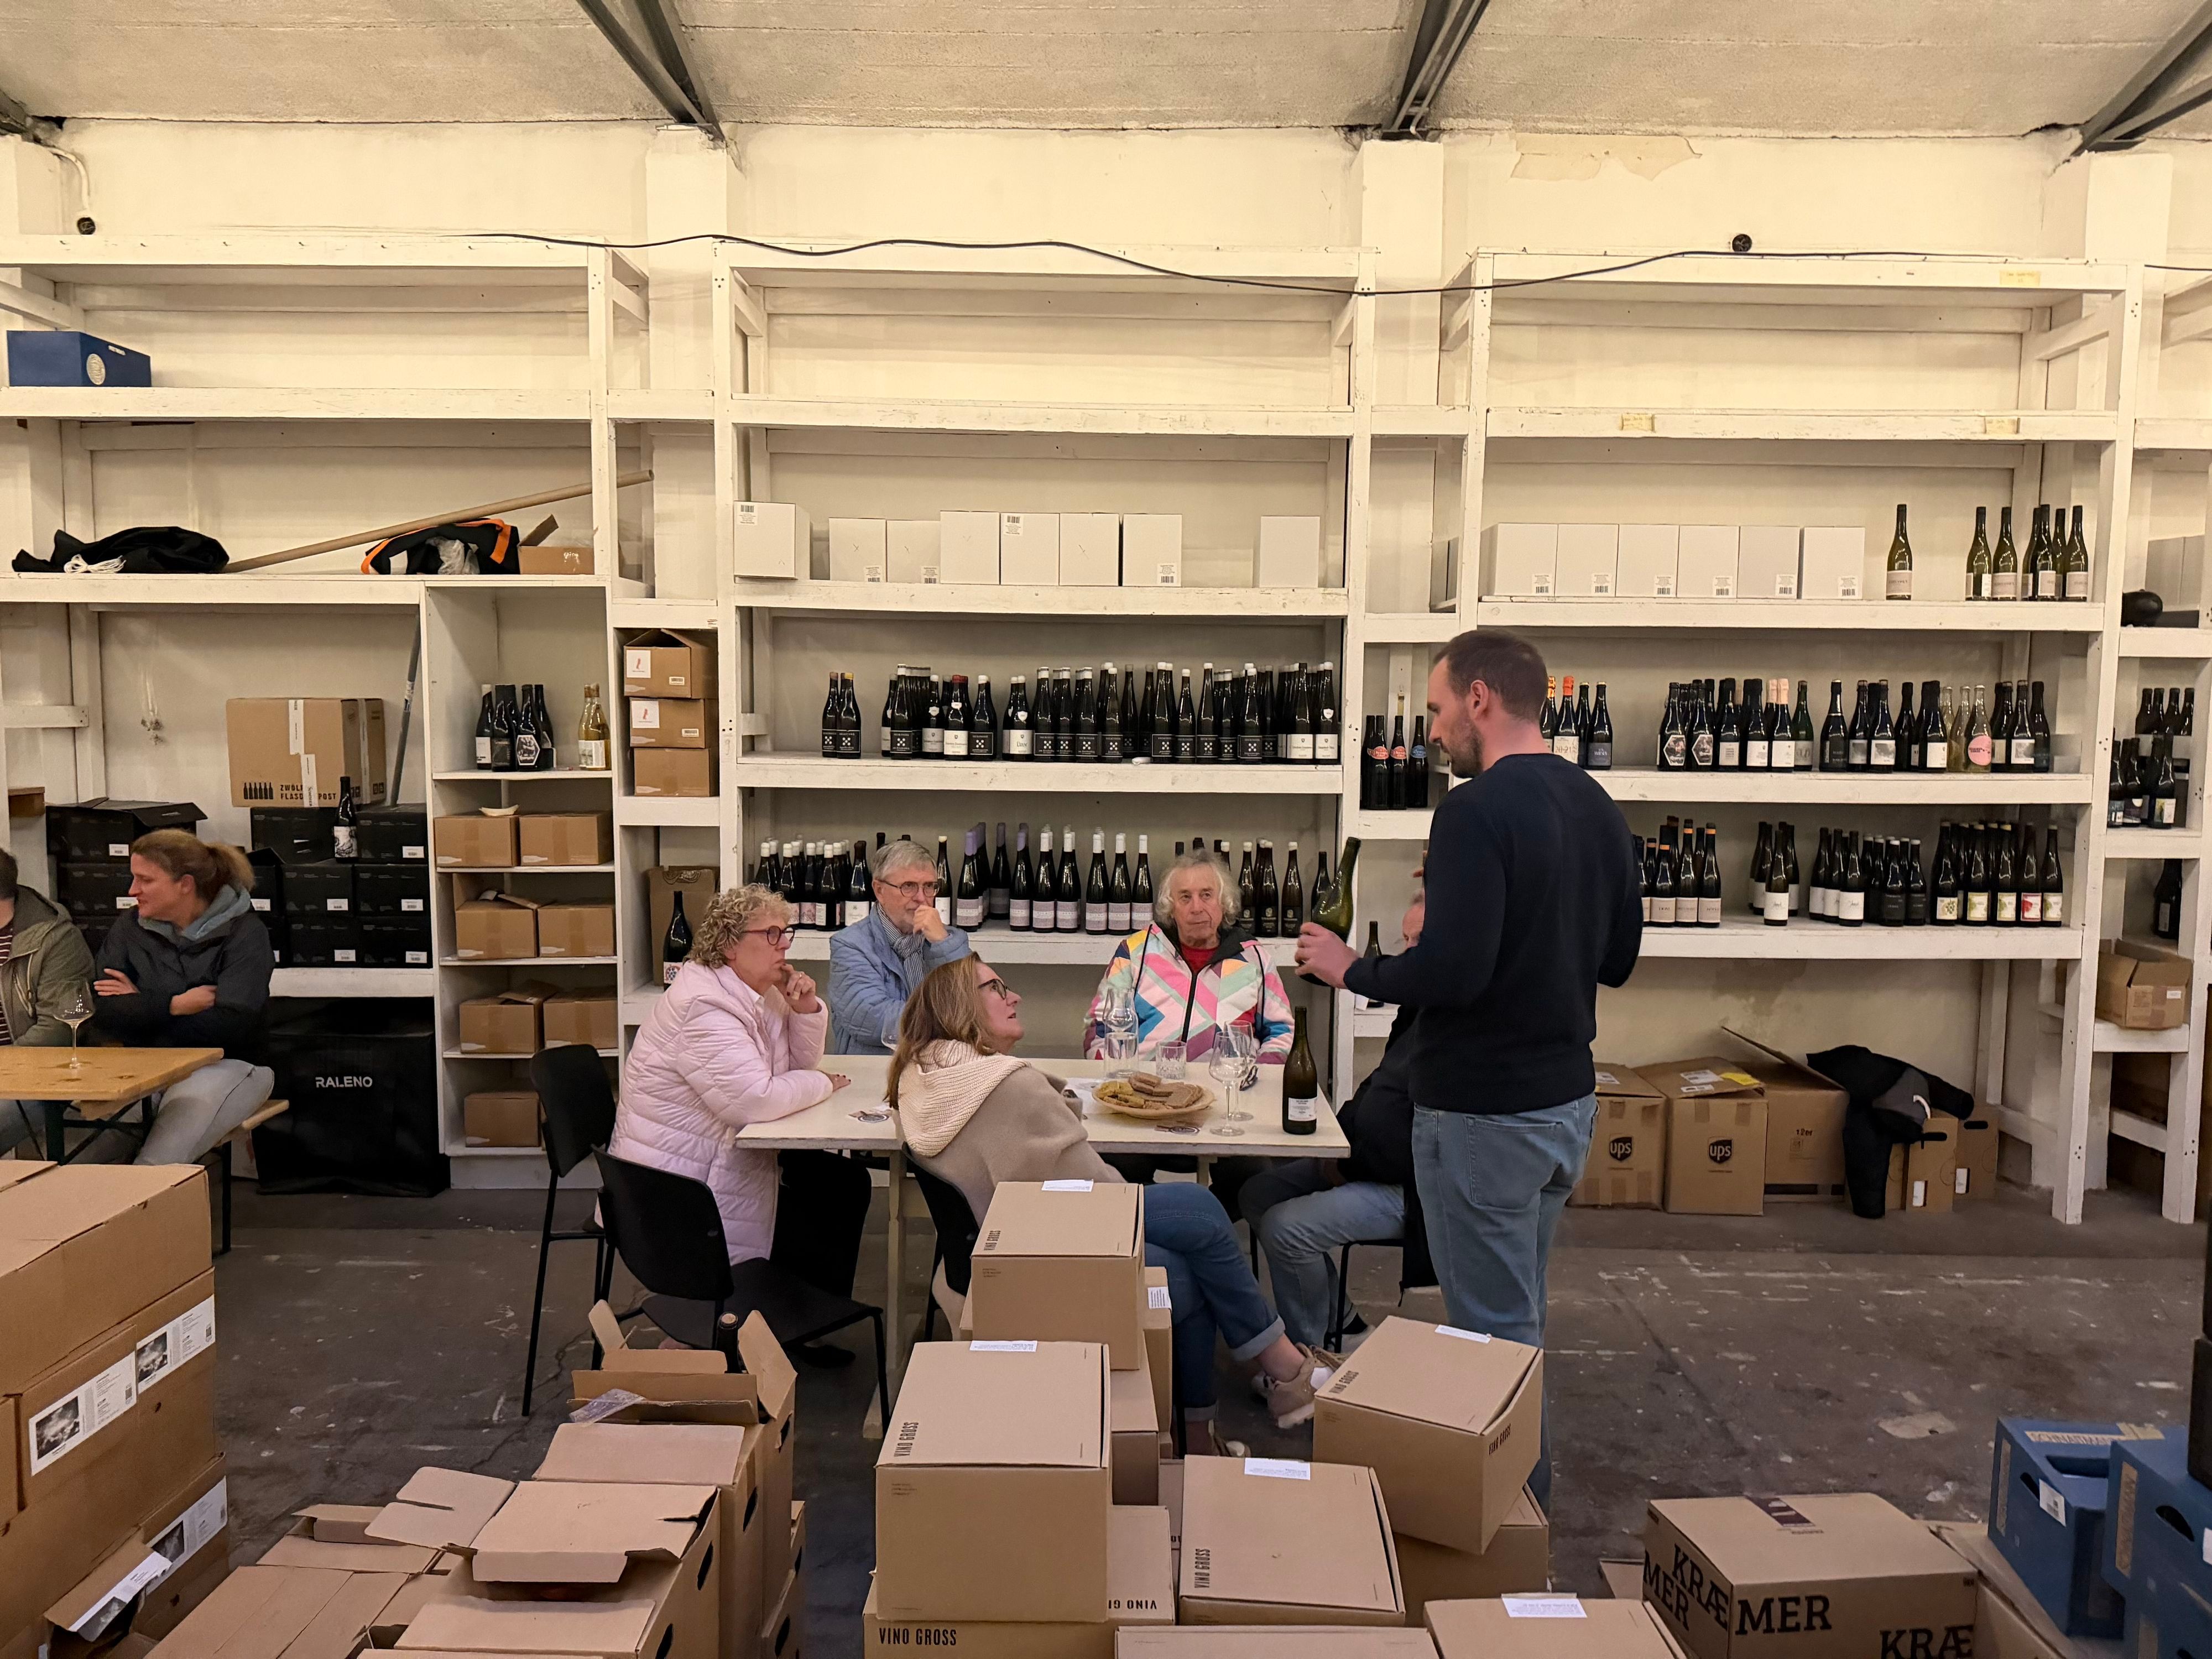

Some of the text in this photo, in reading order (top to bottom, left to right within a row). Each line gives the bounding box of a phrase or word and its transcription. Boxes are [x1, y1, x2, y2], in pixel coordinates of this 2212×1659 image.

[315, 1076, 373, 1088] RALENO
[1610, 1142, 1631, 1159] ups
[1709, 1145, 1731, 1161] ups
[894, 1422, 919, 1457] VINO GROSS
[1194, 1548, 1211, 1588] VINO GROSS
[1644, 1549, 1689, 1631] MER
[1127, 1599, 1157, 1610] VINO
[1735, 1595, 1833, 1635] MER
[879, 1627, 957, 1646] VINO GROSS
